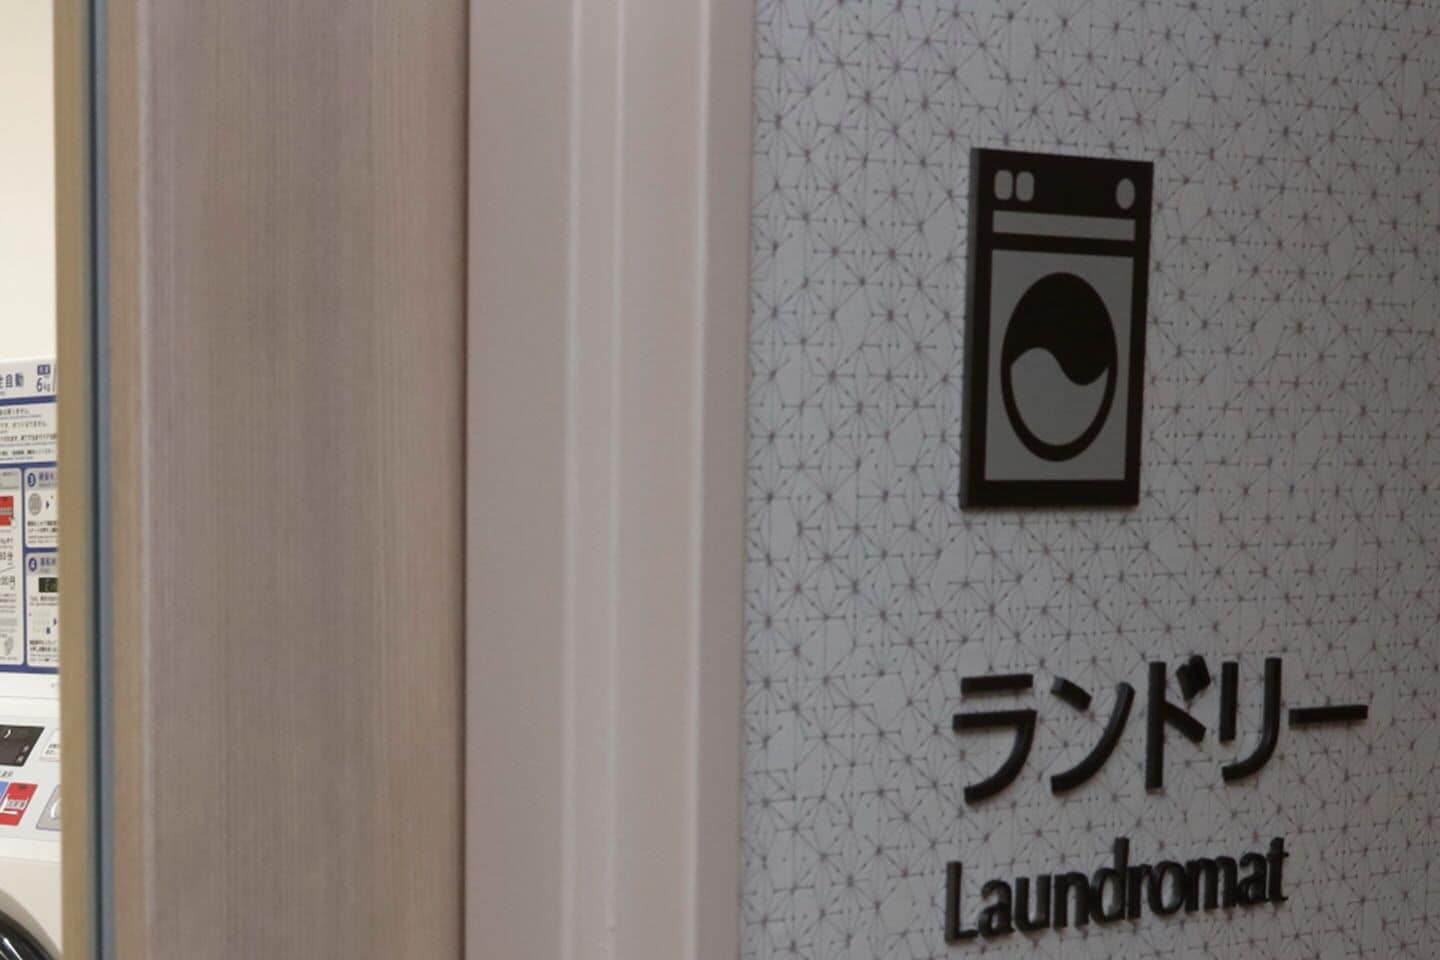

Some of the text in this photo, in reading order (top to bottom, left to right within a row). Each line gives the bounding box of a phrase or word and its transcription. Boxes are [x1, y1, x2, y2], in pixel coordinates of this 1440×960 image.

[952, 655, 1369, 806] ランドリー
[944, 836, 1290, 945] Laundromat
